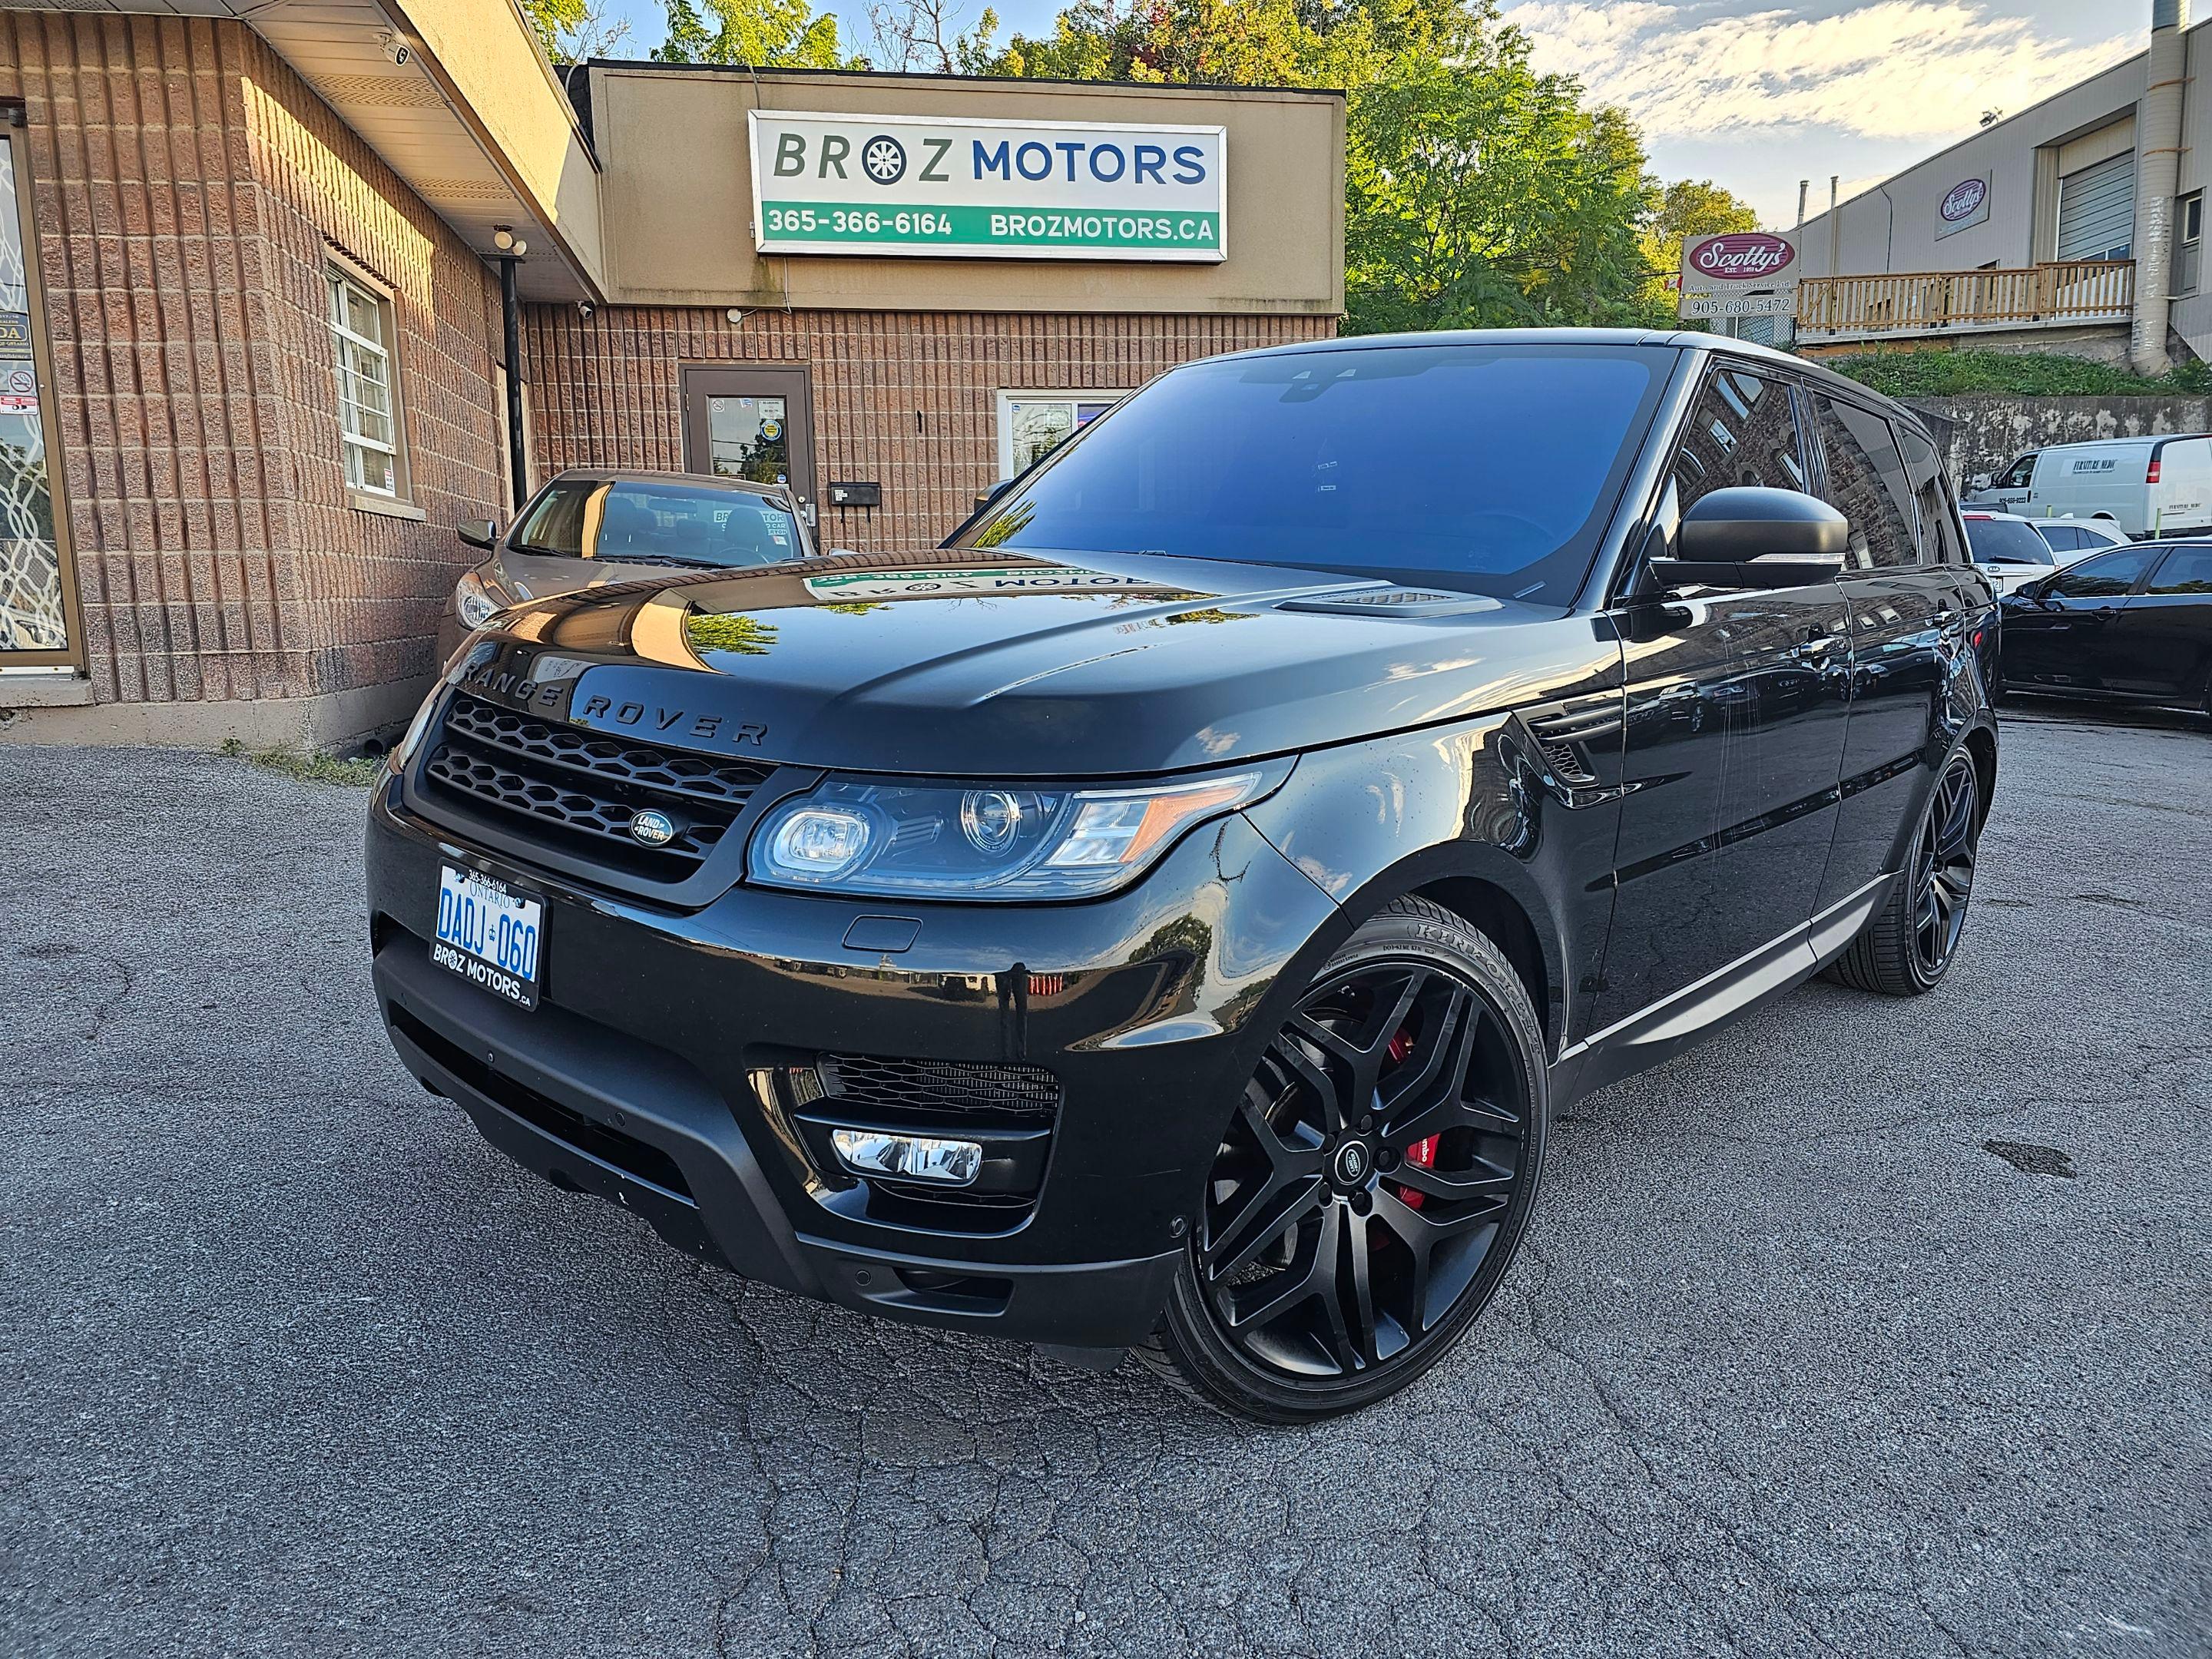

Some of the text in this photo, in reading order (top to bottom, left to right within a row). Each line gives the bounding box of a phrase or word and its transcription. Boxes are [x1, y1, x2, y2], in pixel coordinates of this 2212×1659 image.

[973, 140, 1206, 185] MOTORS
[768, 209, 1214, 240] 365-366-6164 BROZMOTORS.CA
[1700, 242, 1786, 272] Scotty's
[1691, 298, 1790, 315] 905-680-5472
[464, 661, 768, 746] RANGE ROVER
[637, 815, 661, 829] LAND
[637, 825, 665, 841] ROVER
[469, 869, 507, 895] 365-366-6164
[469, 881, 510, 909] ONTARIO
[433, 943, 465, 973] BROZ
